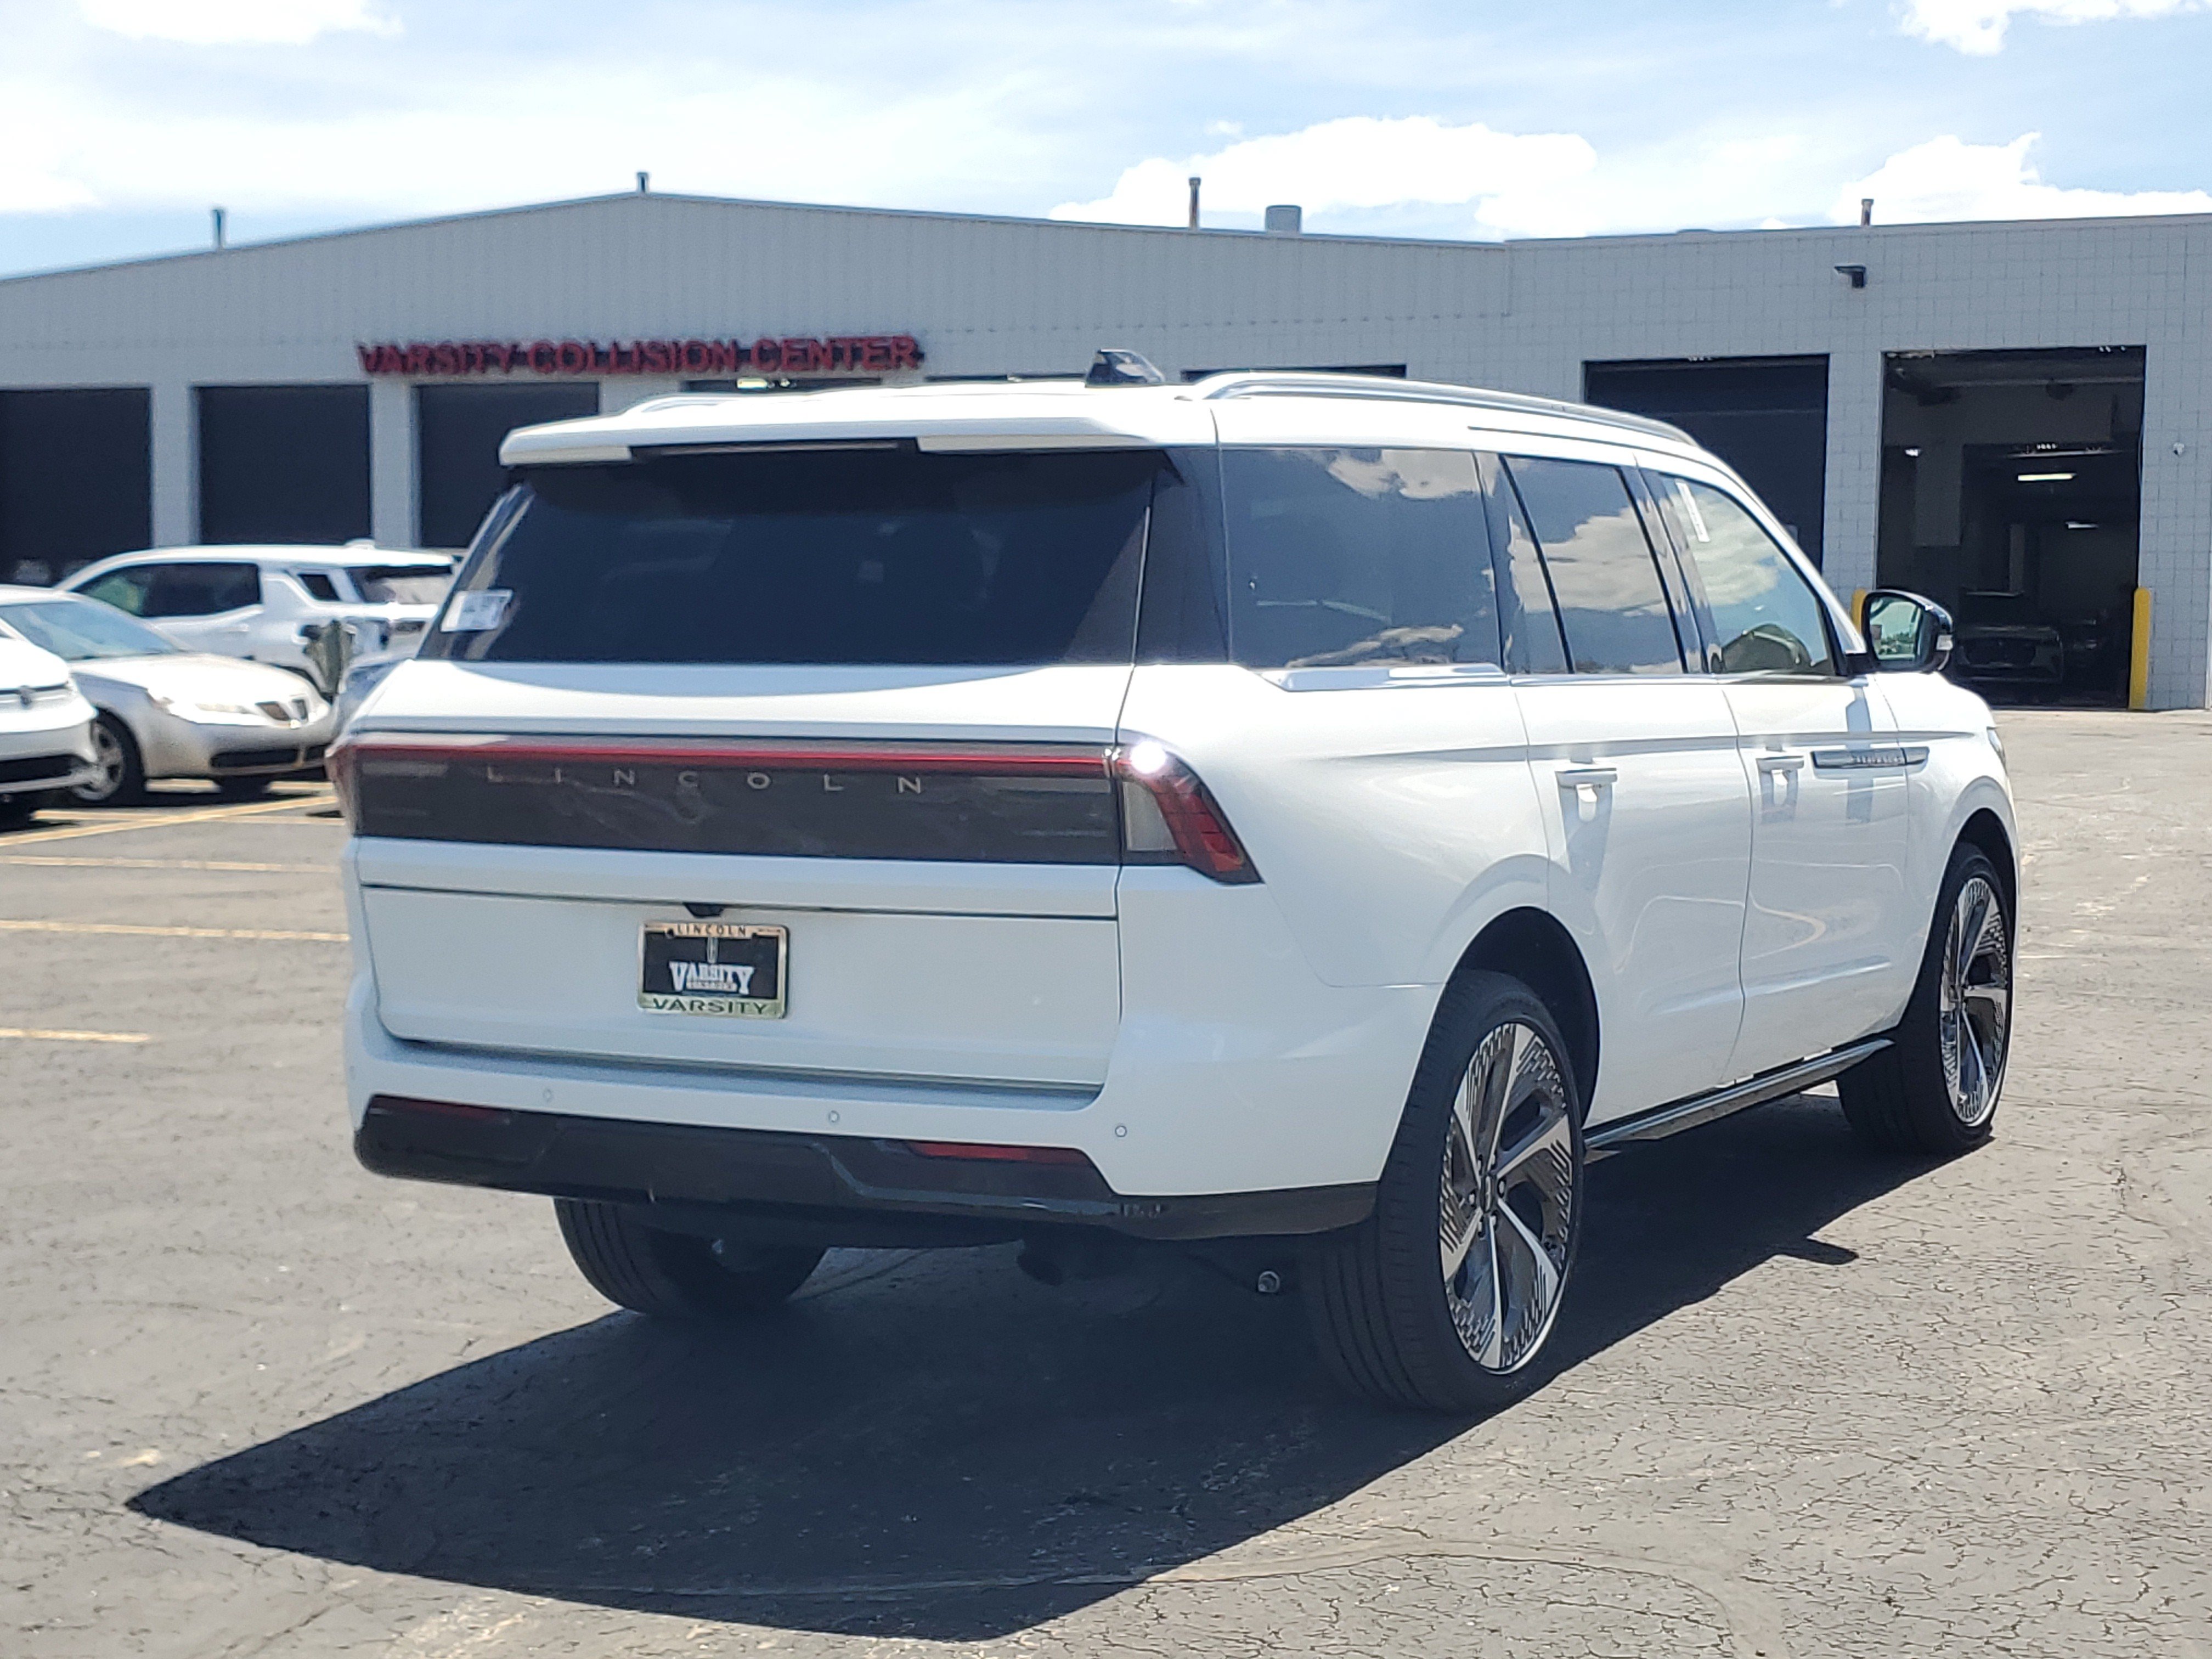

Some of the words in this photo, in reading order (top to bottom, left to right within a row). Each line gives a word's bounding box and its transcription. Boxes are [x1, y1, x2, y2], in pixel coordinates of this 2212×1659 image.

[358, 341, 519, 375] VARSITY
[526, 338, 738, 375] COLLISION
[751, 335, 923, 373] CENTER
[486, 766, 923, 794] LINCOLN
[677, 924, 747, 934] LINCOLN
[652, 997, 768, 1015] VARSITY
